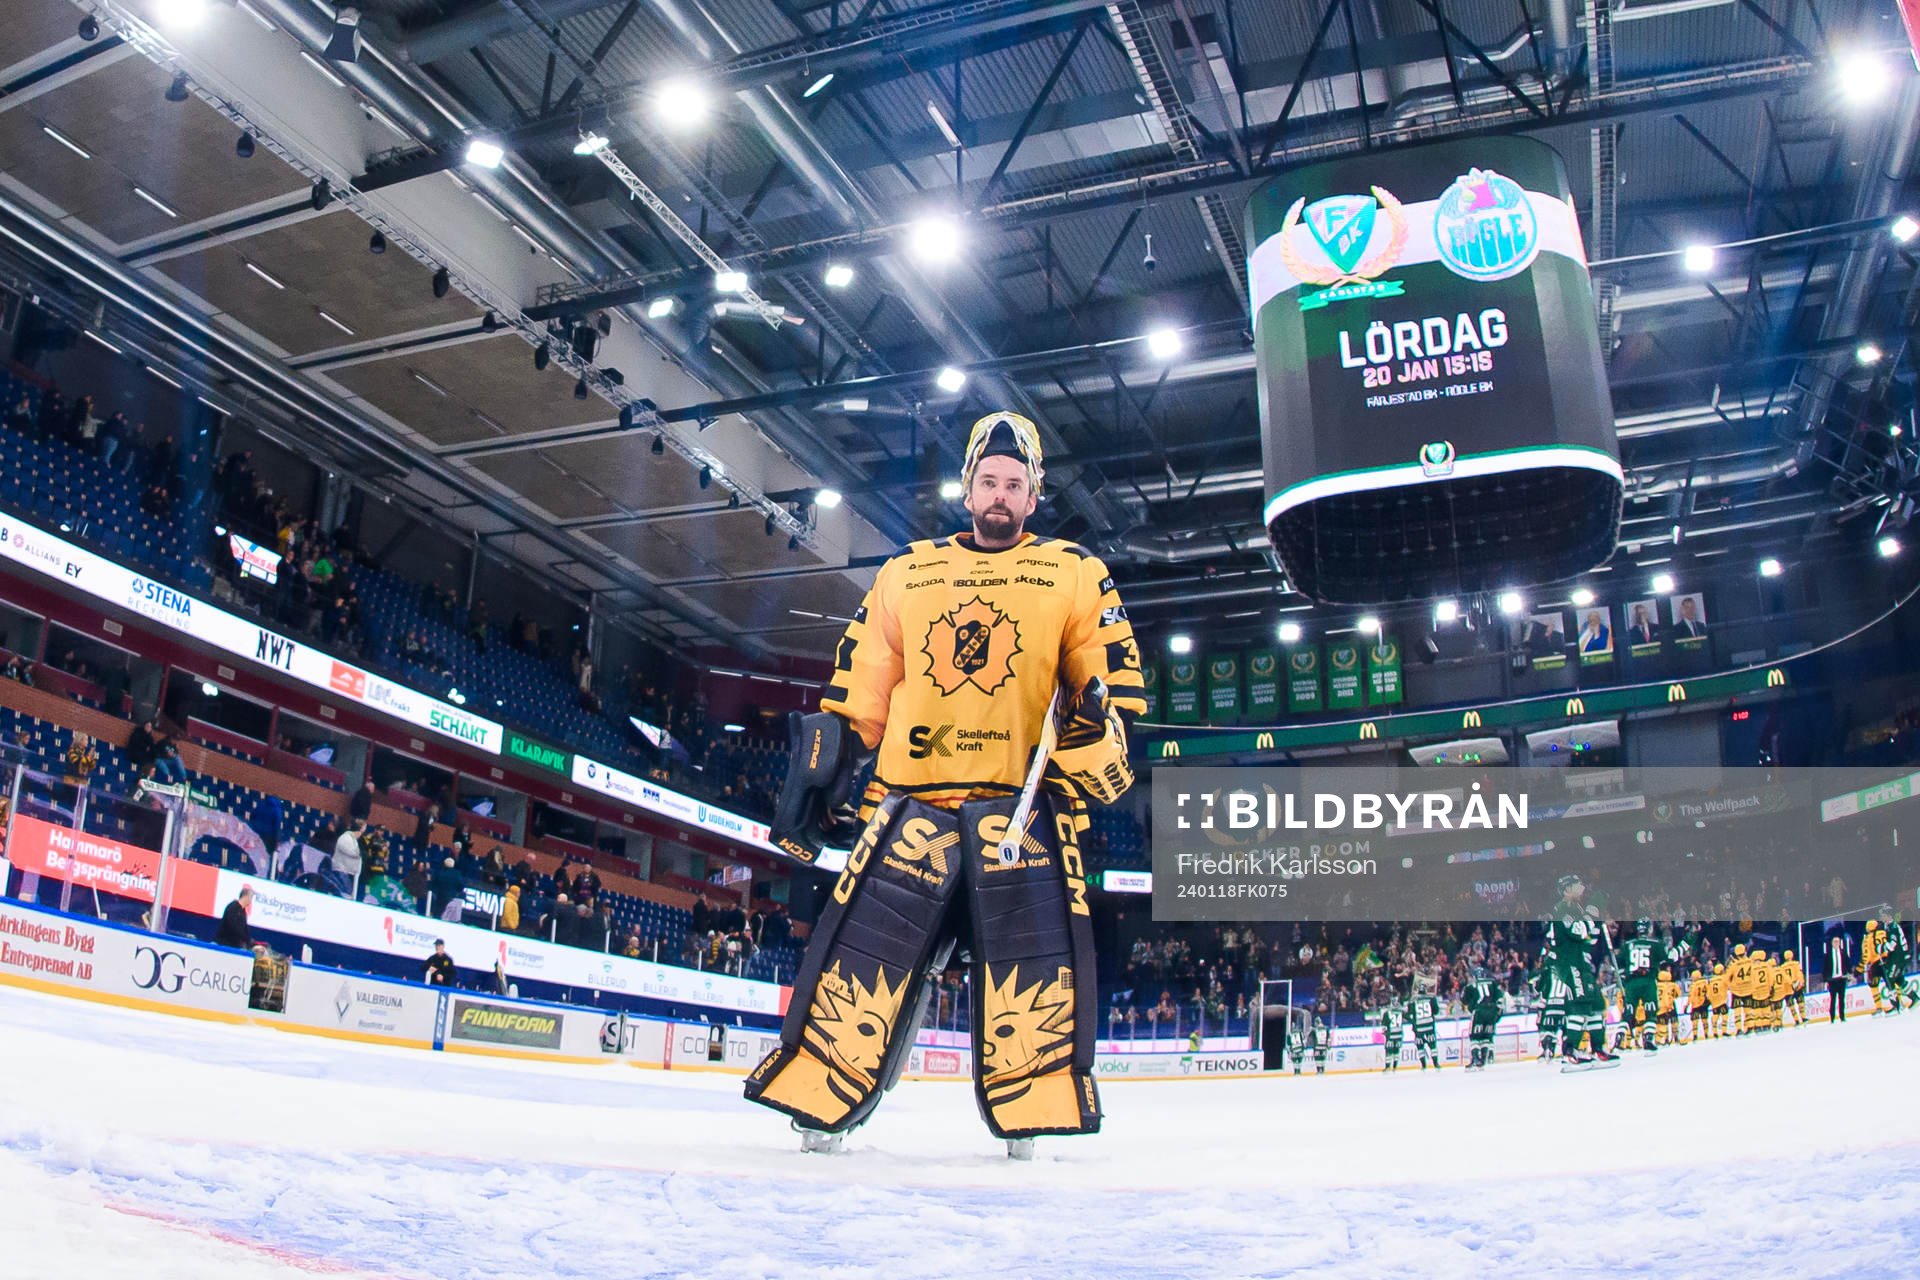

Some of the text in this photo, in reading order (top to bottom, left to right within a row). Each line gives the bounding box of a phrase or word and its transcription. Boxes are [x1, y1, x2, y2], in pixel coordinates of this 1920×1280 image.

[1340, 307, 1509, 369] LÖRDAG
[1363, 350, 1493, 388] 20 JAN 15:15
[65, 562, 83, 578] EY
[955, 578, 1008, 588] BOLIDEN
[1014, 575, 1055, 588] skebo
[905, 578, 946, 590] ŠKODA
[145, 582, 191, 616] STENA
[255, 629, 296, 671] NWT
[430, 709, 489, 745] SCHAKT
[957, 729, 1011, 741] Skellefteå
[511, 737, 566, 771] KLARAVIK
[956, 742, 983, 751] Kraft
[1680, 804, 1702, 816] The
[1705, 795, 1760, 812] Wolfpack
[49, 828, 122, 862] Hammarö
[778, 837, 814, 862] CCM
[834, 807, 890, 904] CCM
[1310, 840, 1371, 858] ROOM
[1055, 812, 1090, 916] CCM
[64, 926, 95, 954] Bygg
[1, 940, 93, 980] Entreprenad AB
[1629, 948, 1650, 972] 96
[356, 991, 403, 1009] VALBRUNA
[461, 1008, 556, 1035] FINNFOAM
[1196, 1058, 1258, 1072] TEKNOS
